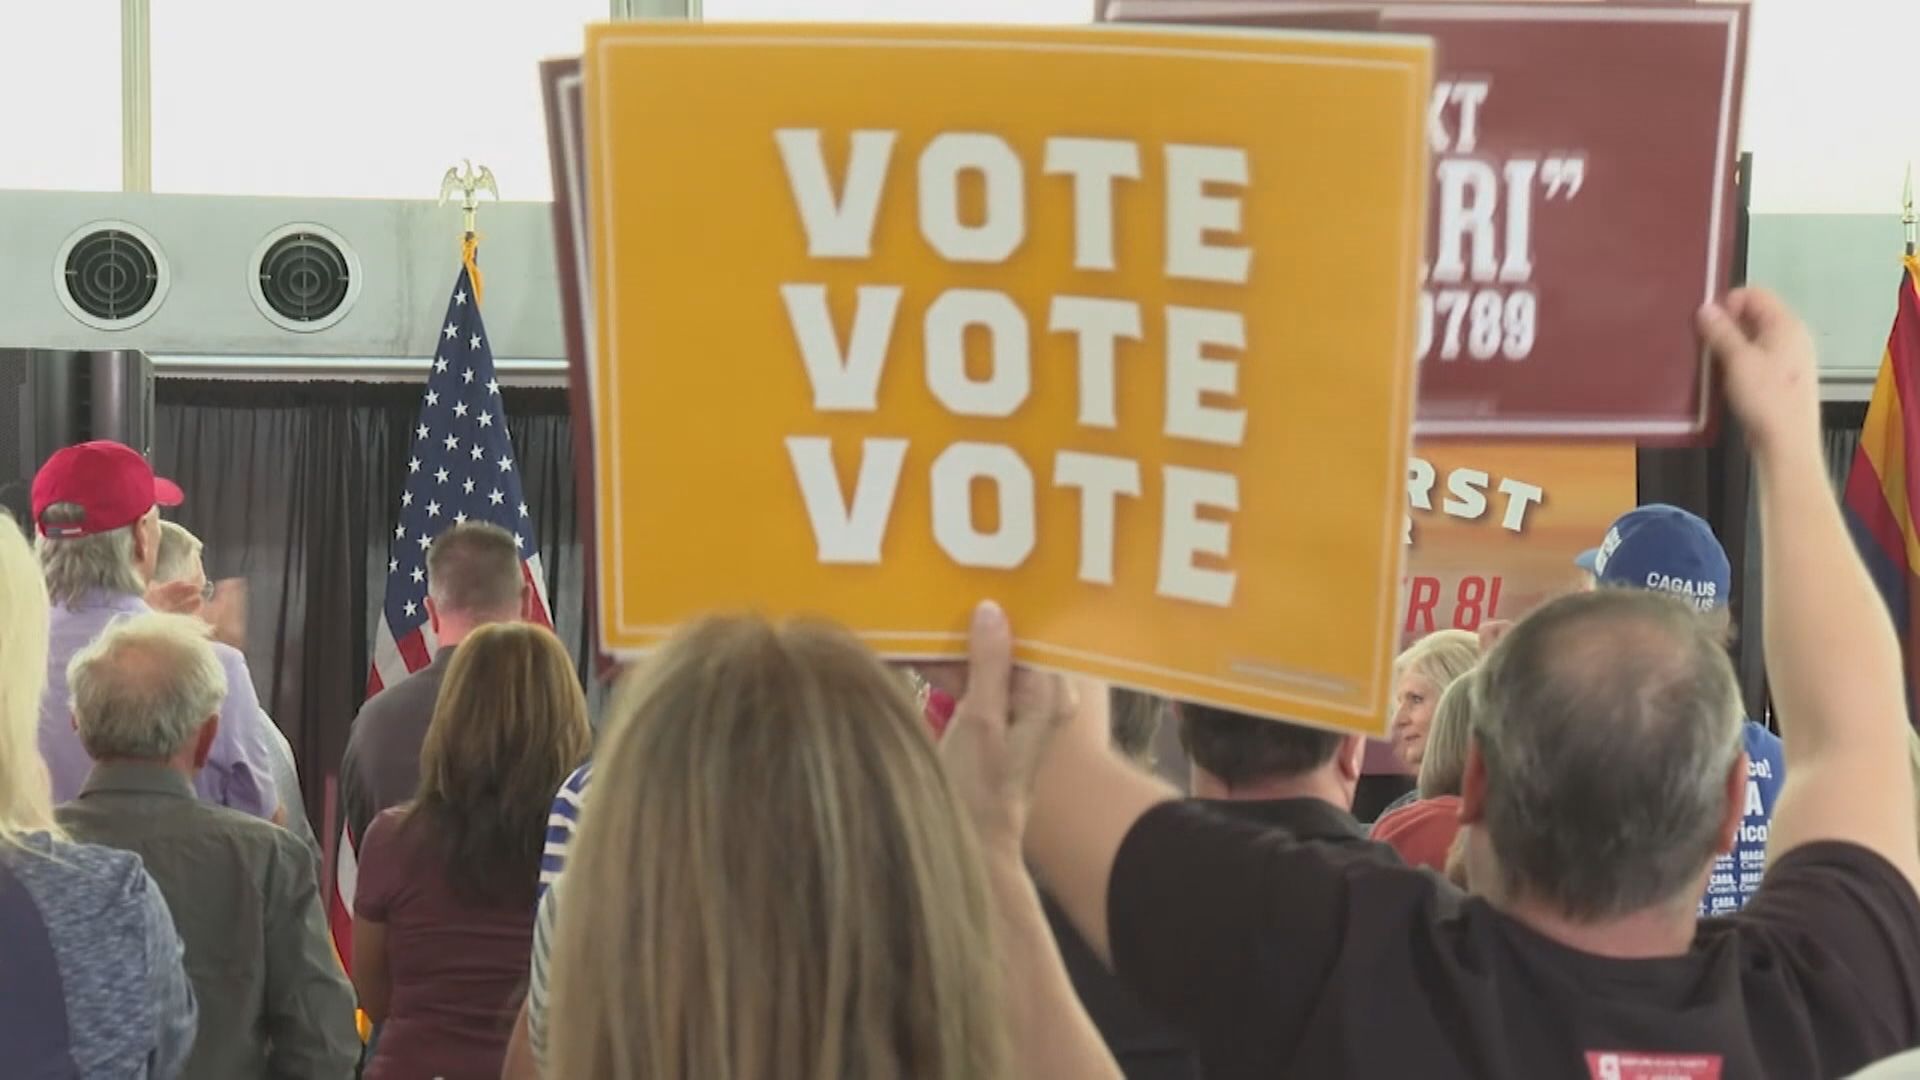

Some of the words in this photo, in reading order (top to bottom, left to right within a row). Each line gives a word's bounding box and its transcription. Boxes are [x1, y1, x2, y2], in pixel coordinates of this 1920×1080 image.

[775, 128, 1252, 283] VOTE
[781, 283, 1246, 445] VOTE
[785, 436, 1239, 607] VOTE
